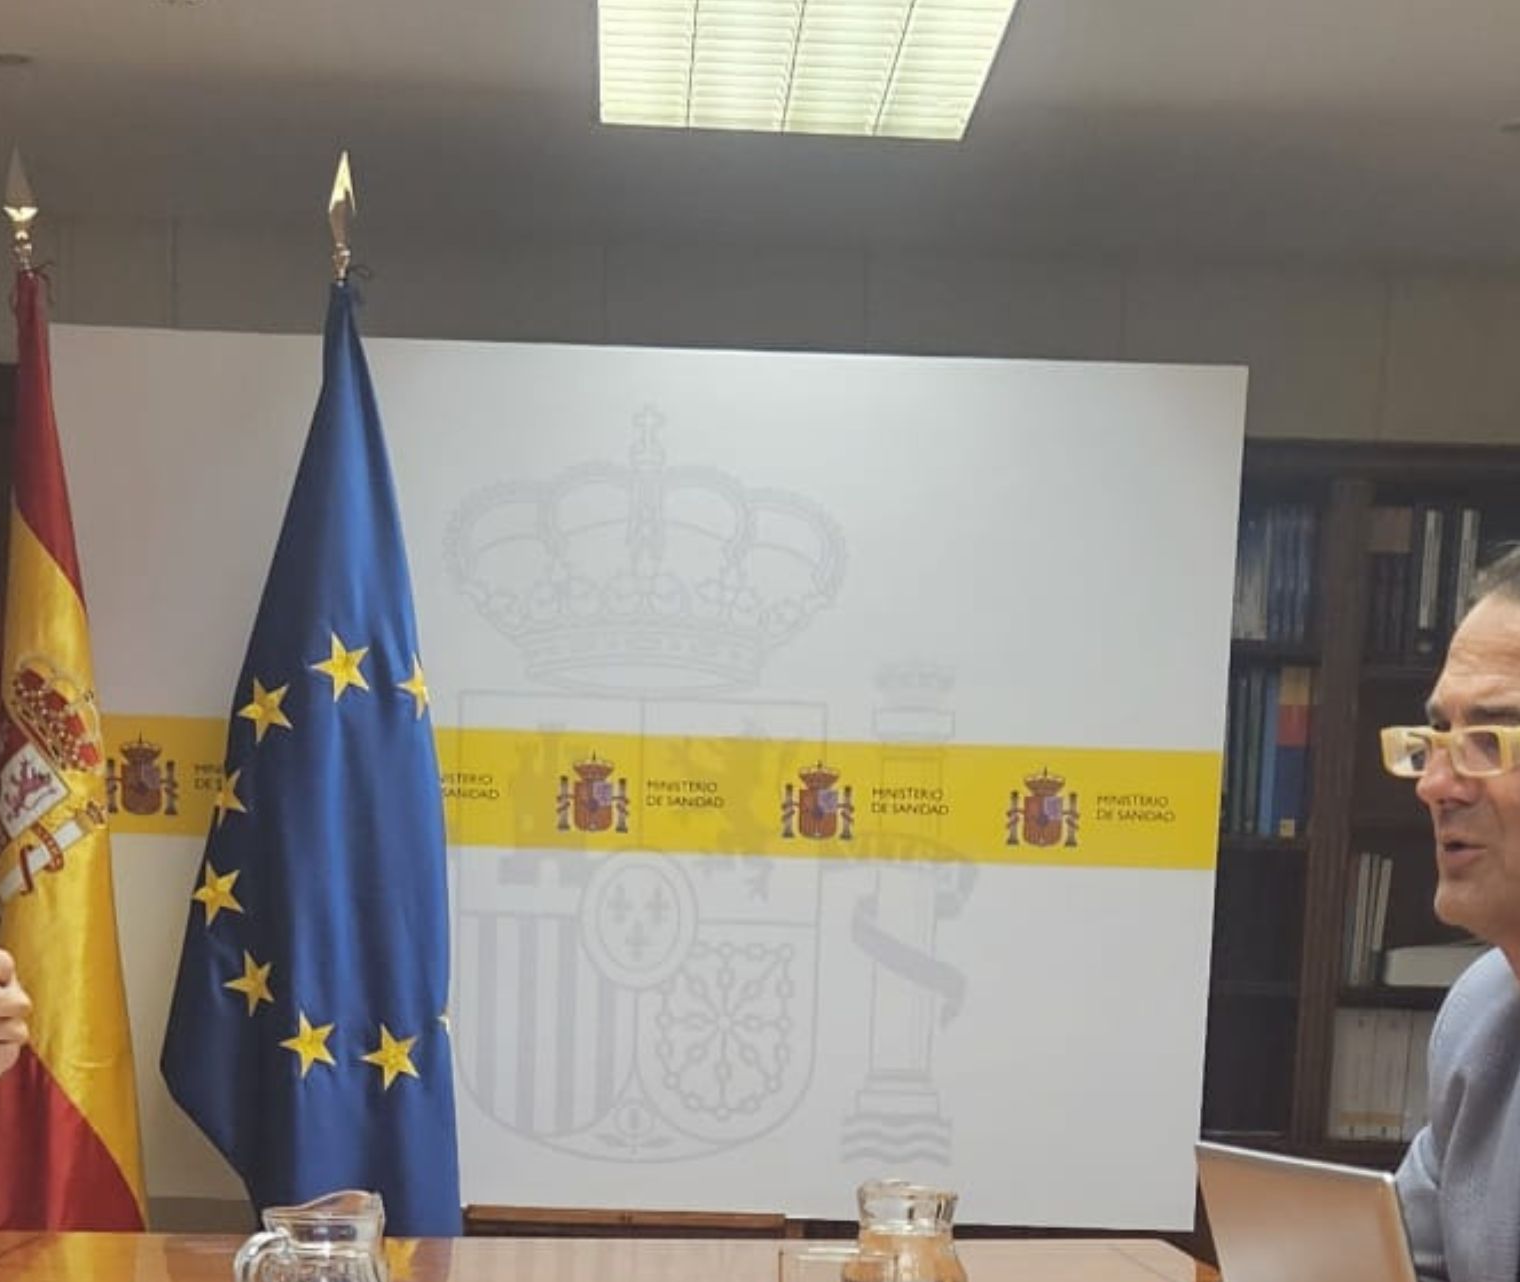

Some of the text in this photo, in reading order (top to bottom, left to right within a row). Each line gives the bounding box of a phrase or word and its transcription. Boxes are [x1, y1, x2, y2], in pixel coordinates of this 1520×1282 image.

[646, 780, 718, 793] MINISTERIO
[871, 787, 944, 800] MINISTERIO
[645, 795, 726, 809] DE SANIDAD
[1096, 795, 1170, 808] MINISTERIO
[871, 802, 950, 816] DE SANIDAD
[1096, 808, 1176, 823] DE SANIDAD
